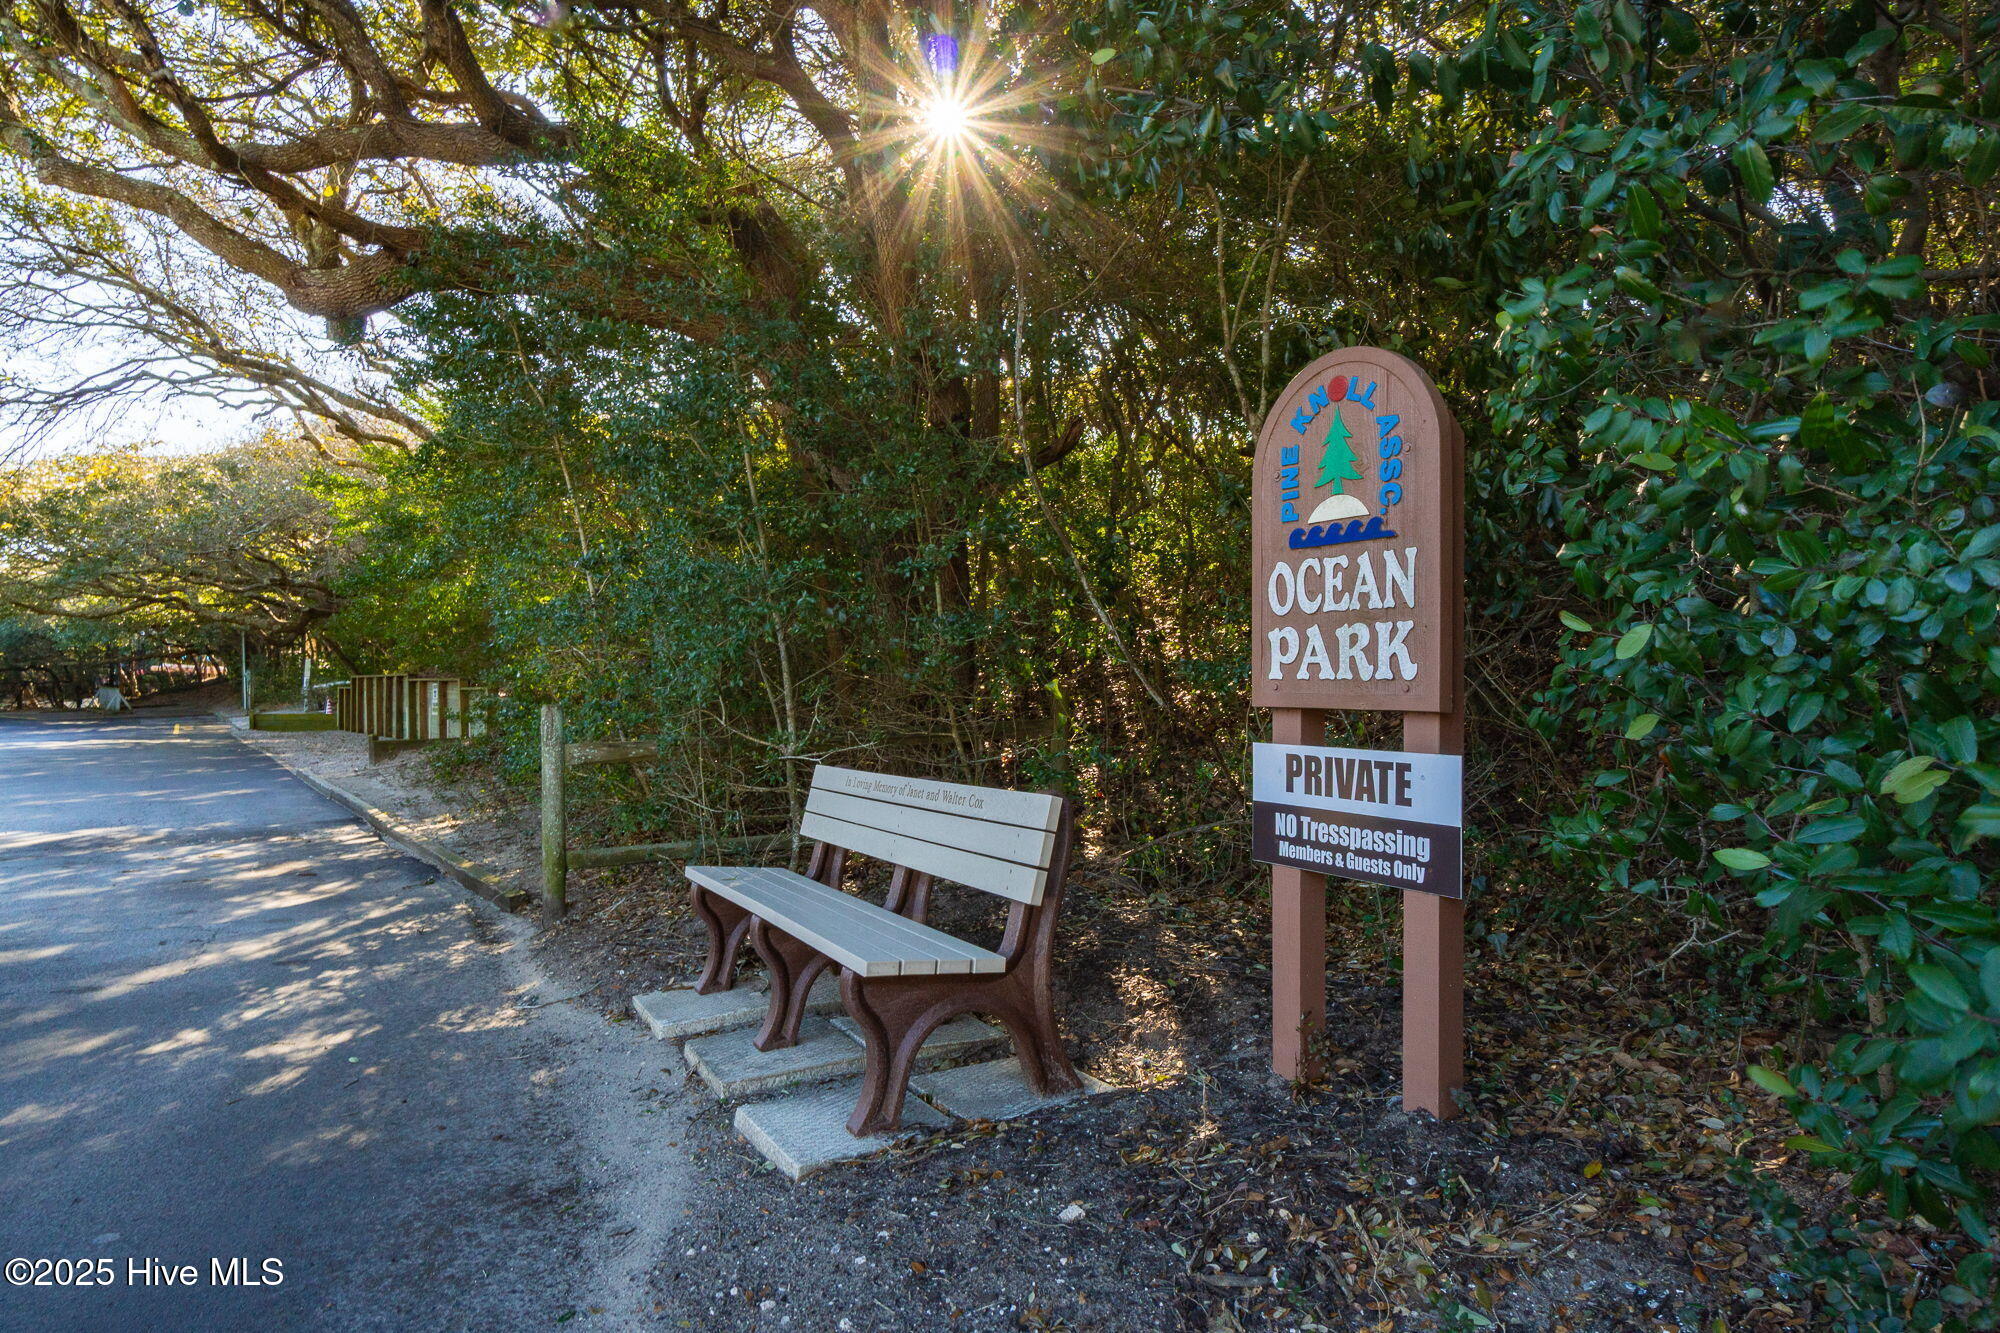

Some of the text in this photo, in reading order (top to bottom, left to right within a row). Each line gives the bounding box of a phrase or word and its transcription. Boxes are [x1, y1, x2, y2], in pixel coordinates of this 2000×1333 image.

[1280, 444, 1300, 523] PINE
[1376, 414, 1403, 516] ASSC.
[1268, 546, 1418, 616] OCEAN
[1267, 620, 1418, 681] PARK
[852, 777, 873, 793] Loving
[872, 780, 899, 798] Memory
[898, 784, 908, 797] of
[925, 789, 941, 802] and
[942, 789, 967, 806] Walter
[968, 793, 985, 809] Cox
[1285, 753, 1412, 808] PRIVATE
[1275, 812, 1431, 864] NO Tresspassing
[1278, 840, 1426, 884] Members & Guests Only
